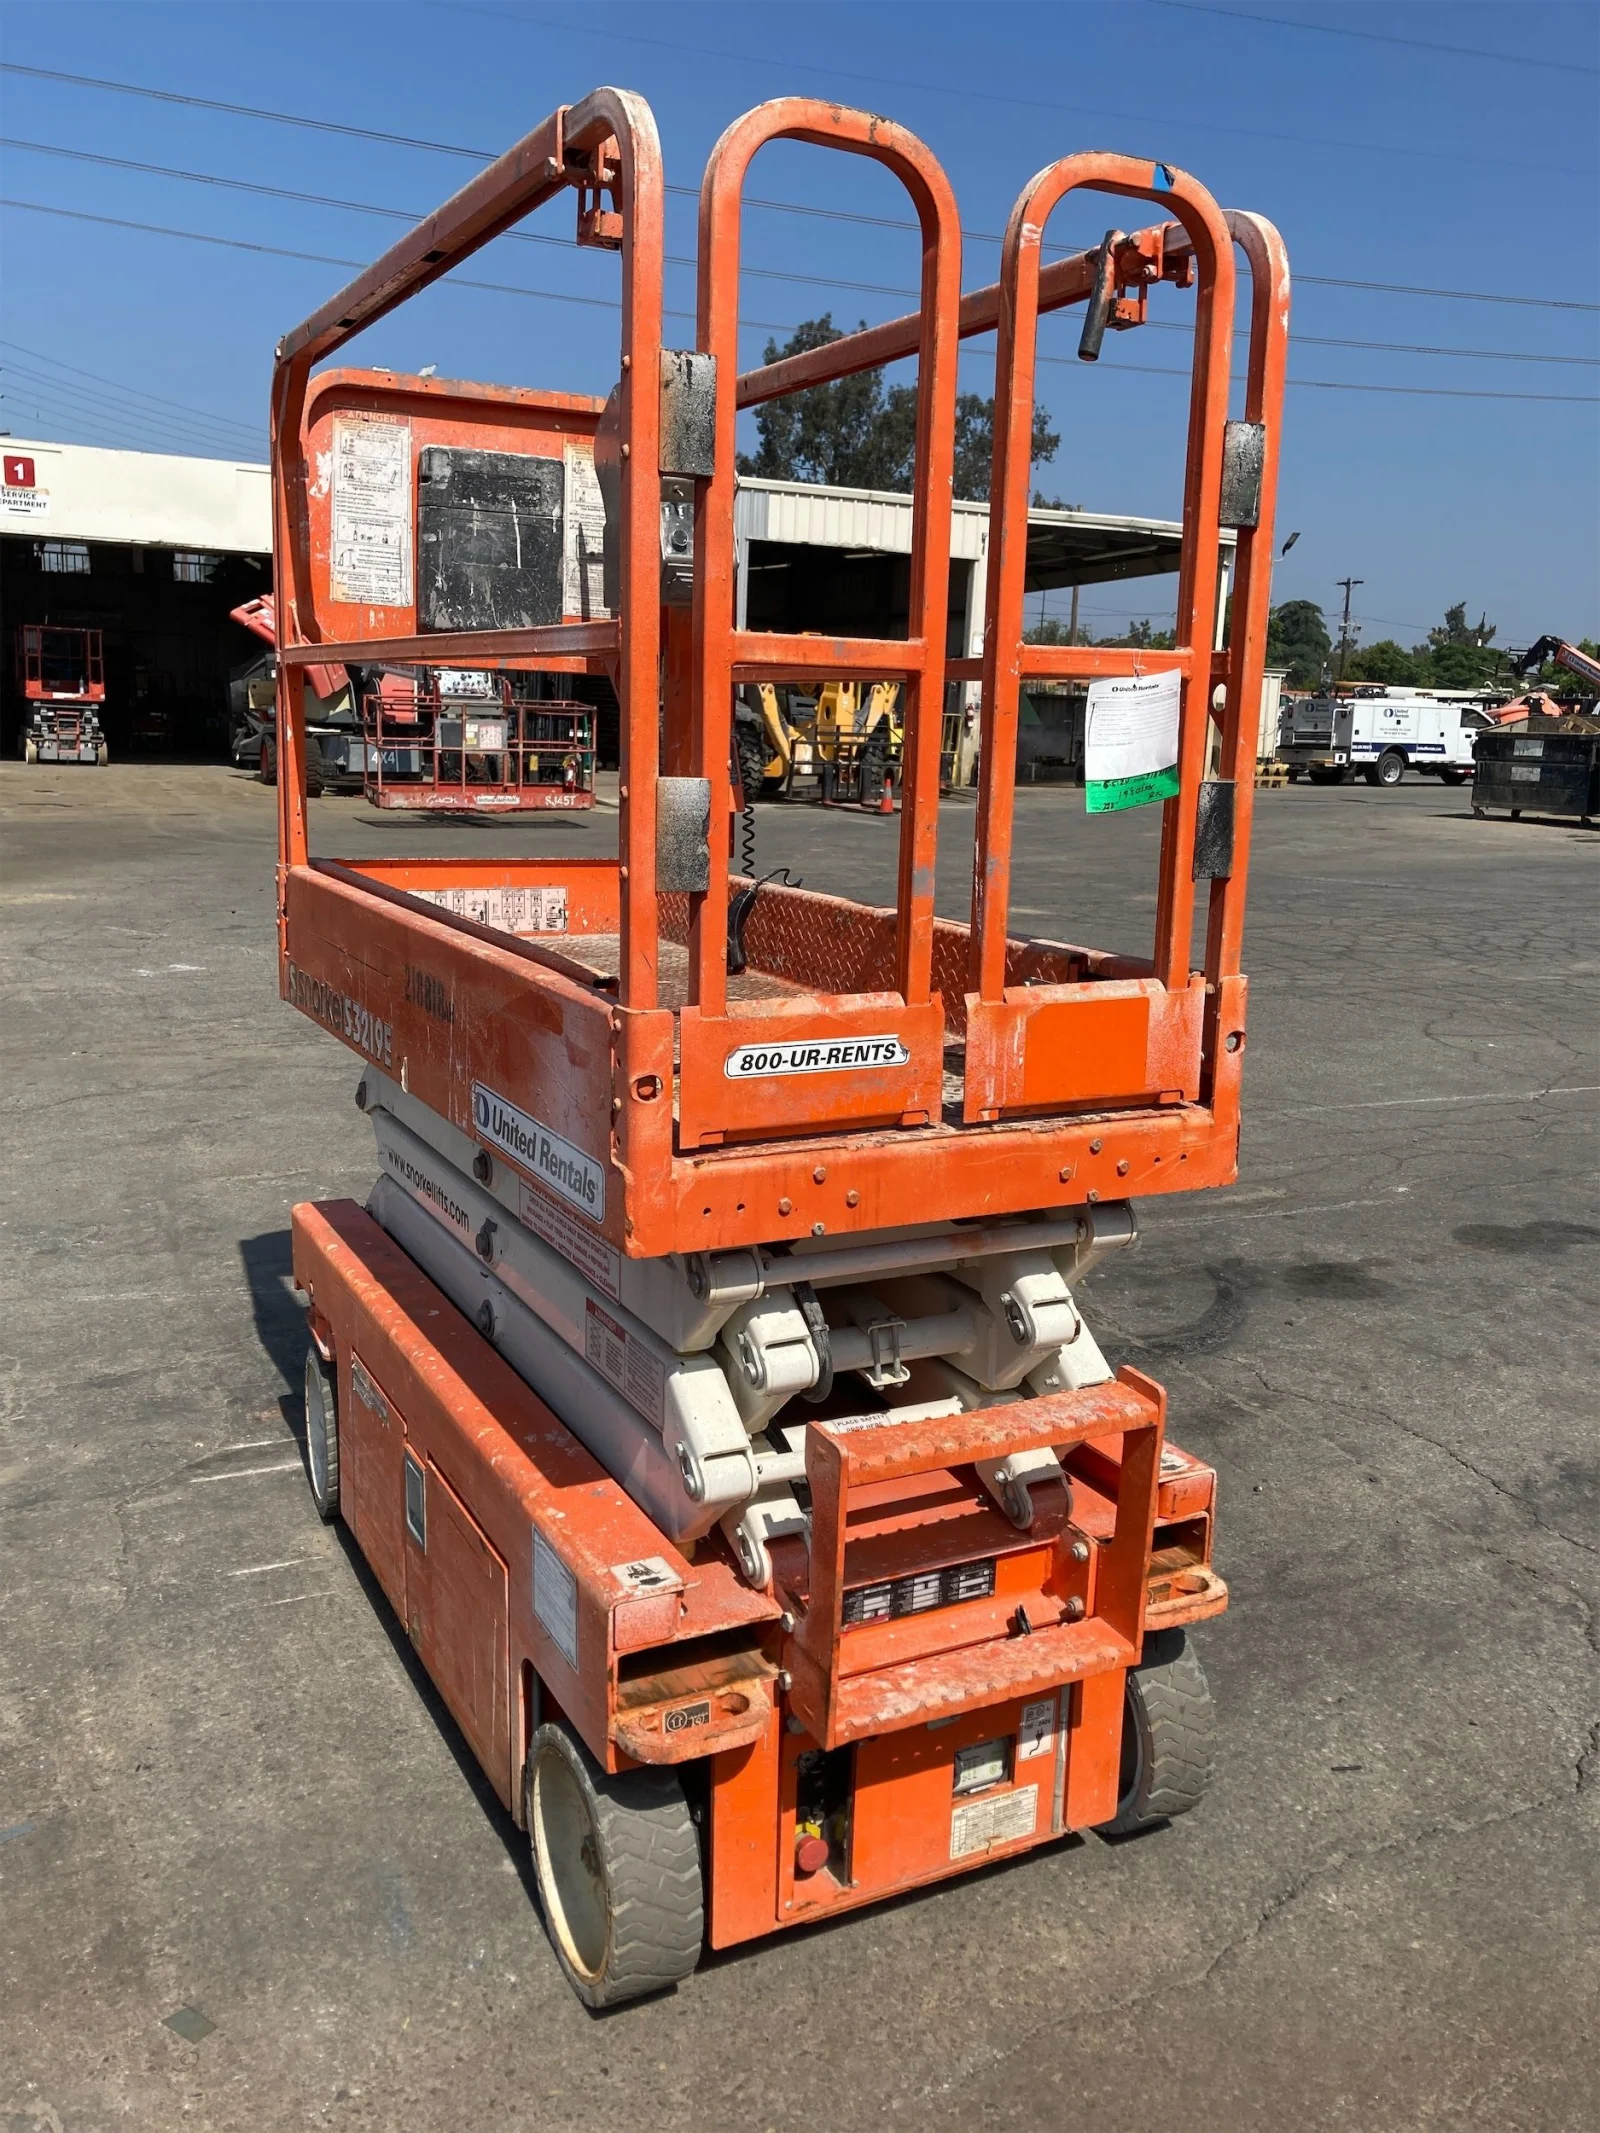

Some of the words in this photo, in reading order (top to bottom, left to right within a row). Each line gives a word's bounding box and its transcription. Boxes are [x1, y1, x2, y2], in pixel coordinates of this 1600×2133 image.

[355, 411, 397, 424] DANGER
[13, 462, 24, 481] 1
[2, 490, 37, 500] SERVICE
[371, 751, 396, 764] 4X4
[344, 998, 393, 1070] S3219E
[740, 1043, 897, 1071] 800-UR-RENTS
[492, 1104, 537, 1162] United
[539, 1136, 597, 1205] Rentals
[388, 1150, 470, 1233] www.snorkellifts.com
[837, 1418, 859, 1427] PLACE
[860, 1414, 885, 1422] SAFETY
